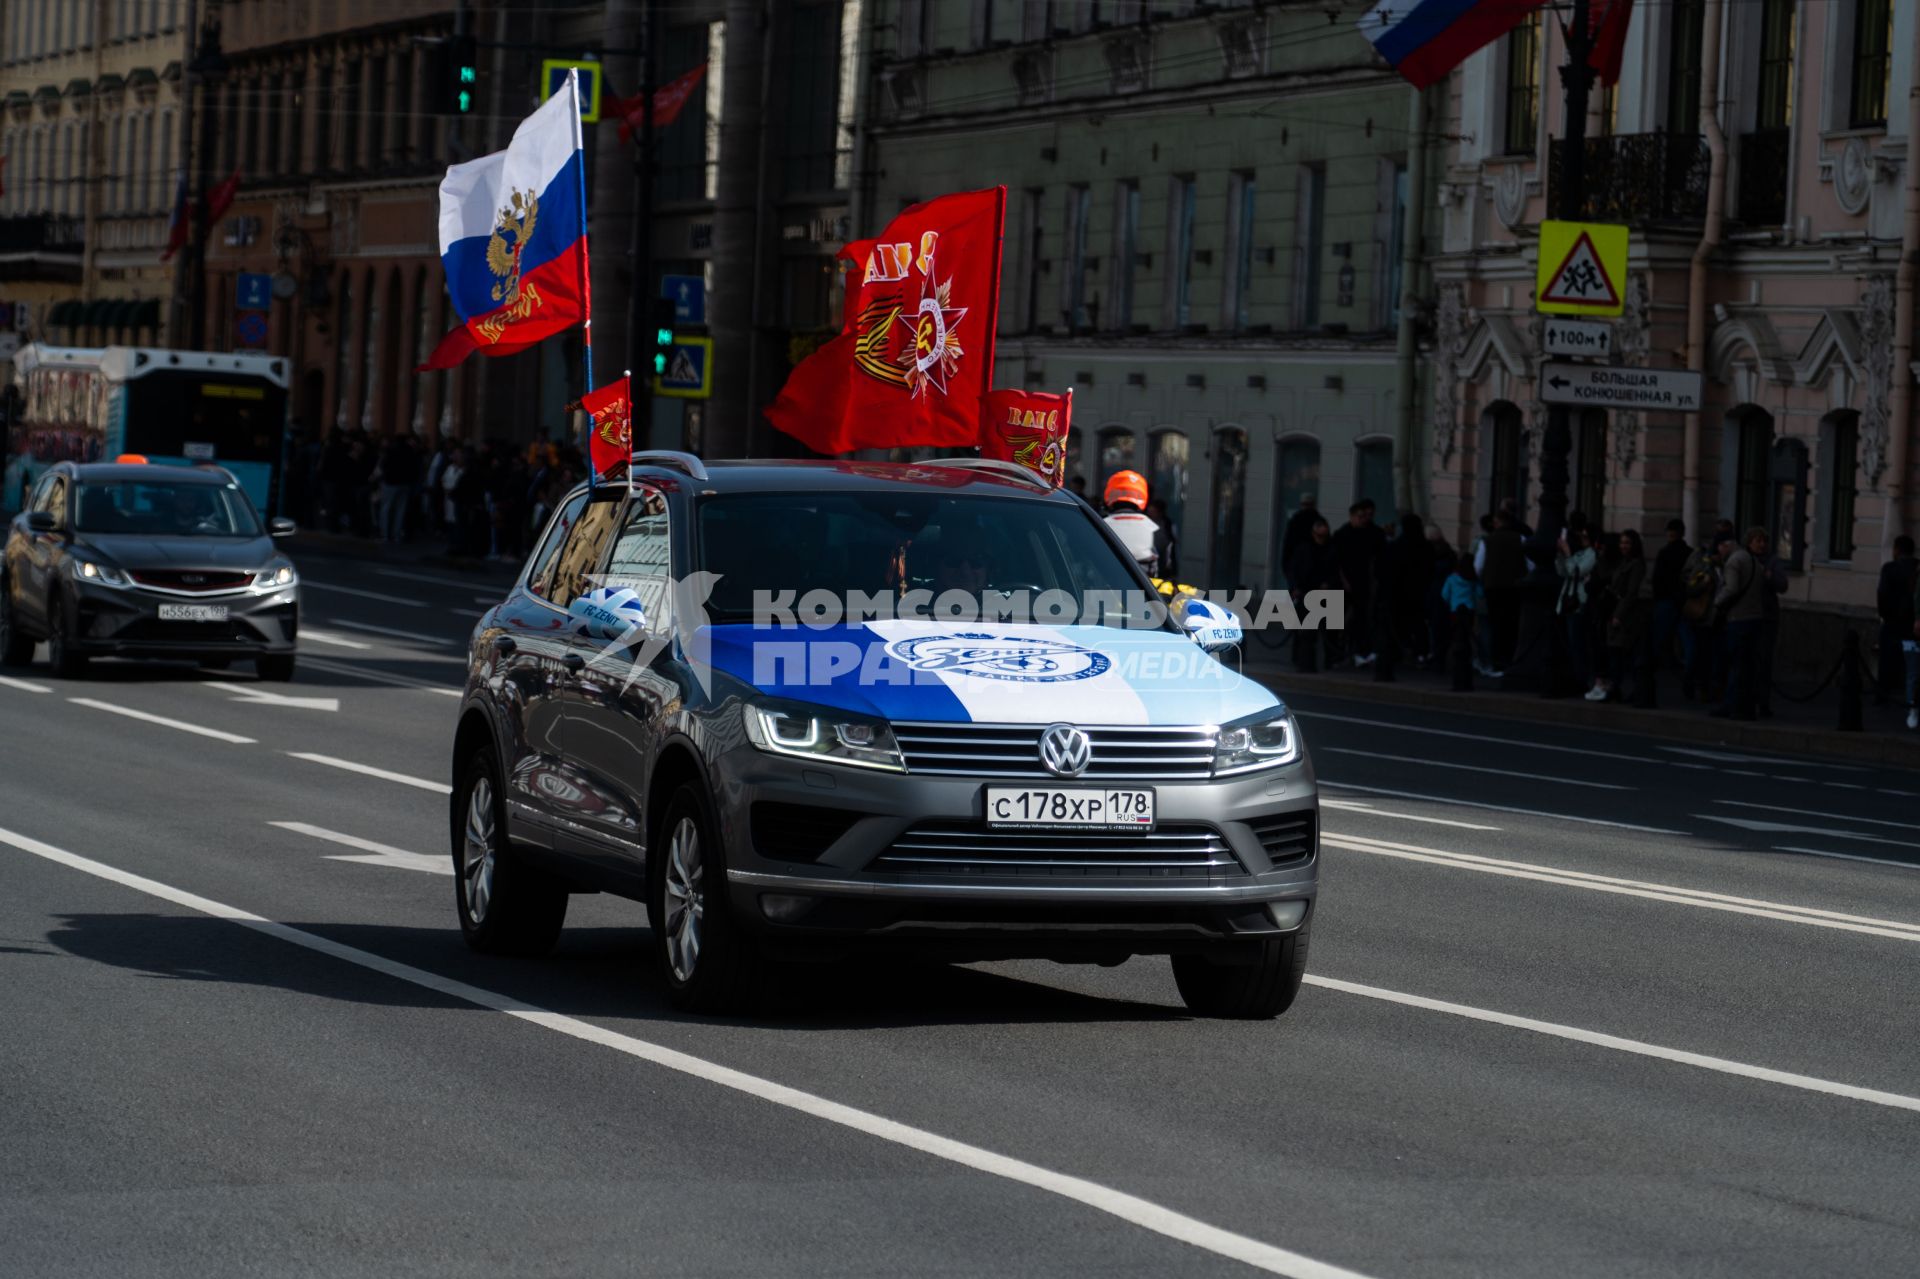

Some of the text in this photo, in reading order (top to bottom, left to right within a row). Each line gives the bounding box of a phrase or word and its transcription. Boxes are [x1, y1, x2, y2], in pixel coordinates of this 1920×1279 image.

[1591, 371, 1658, 387] БОЛЬШАЯ
[1574, 386, 1672, 403] КОНЮШЕННАЯ
[583, 604, 620, 626] FC ZENIT
[1212, 628, 1239, 639] FC ZENIT
[995, 791, 1146, 820] С178ХР 178
[1116, 813, 1136, 822] RUS
